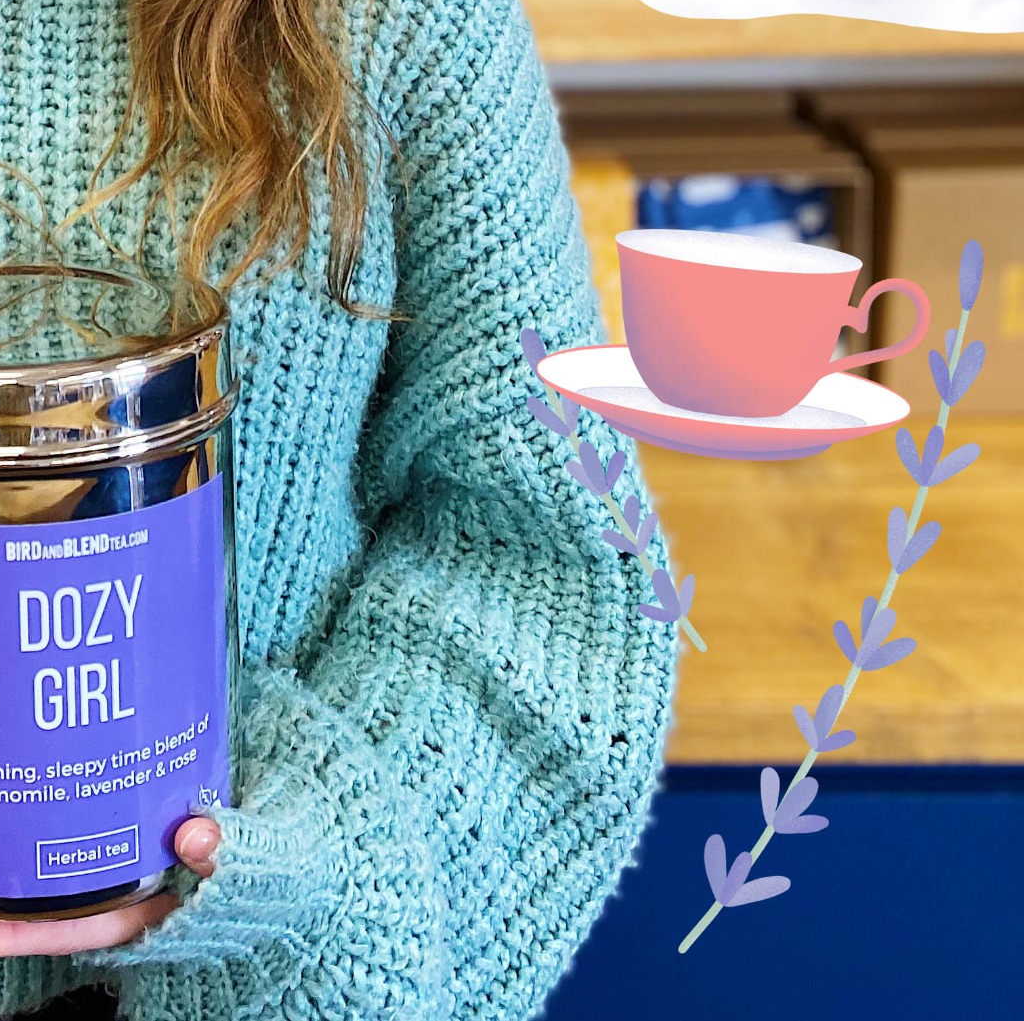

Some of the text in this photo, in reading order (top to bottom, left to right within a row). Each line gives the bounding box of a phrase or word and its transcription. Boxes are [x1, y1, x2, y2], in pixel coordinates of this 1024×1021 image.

[18, 574, 143, 653] DOZY
[33, 658, 136, 731] GIRL
[46, 758, 107, 779] sleepy
[111, 745, 151, 770] time
[154, 726, 195, 755] blend
[197, 712, 210, 735] of
[75, 766, 152, 799] lavender
[155, 760, 167, 779] &
[169, 747, 198, 773] rose
[47, 839, 130, 867] Herbal tea
